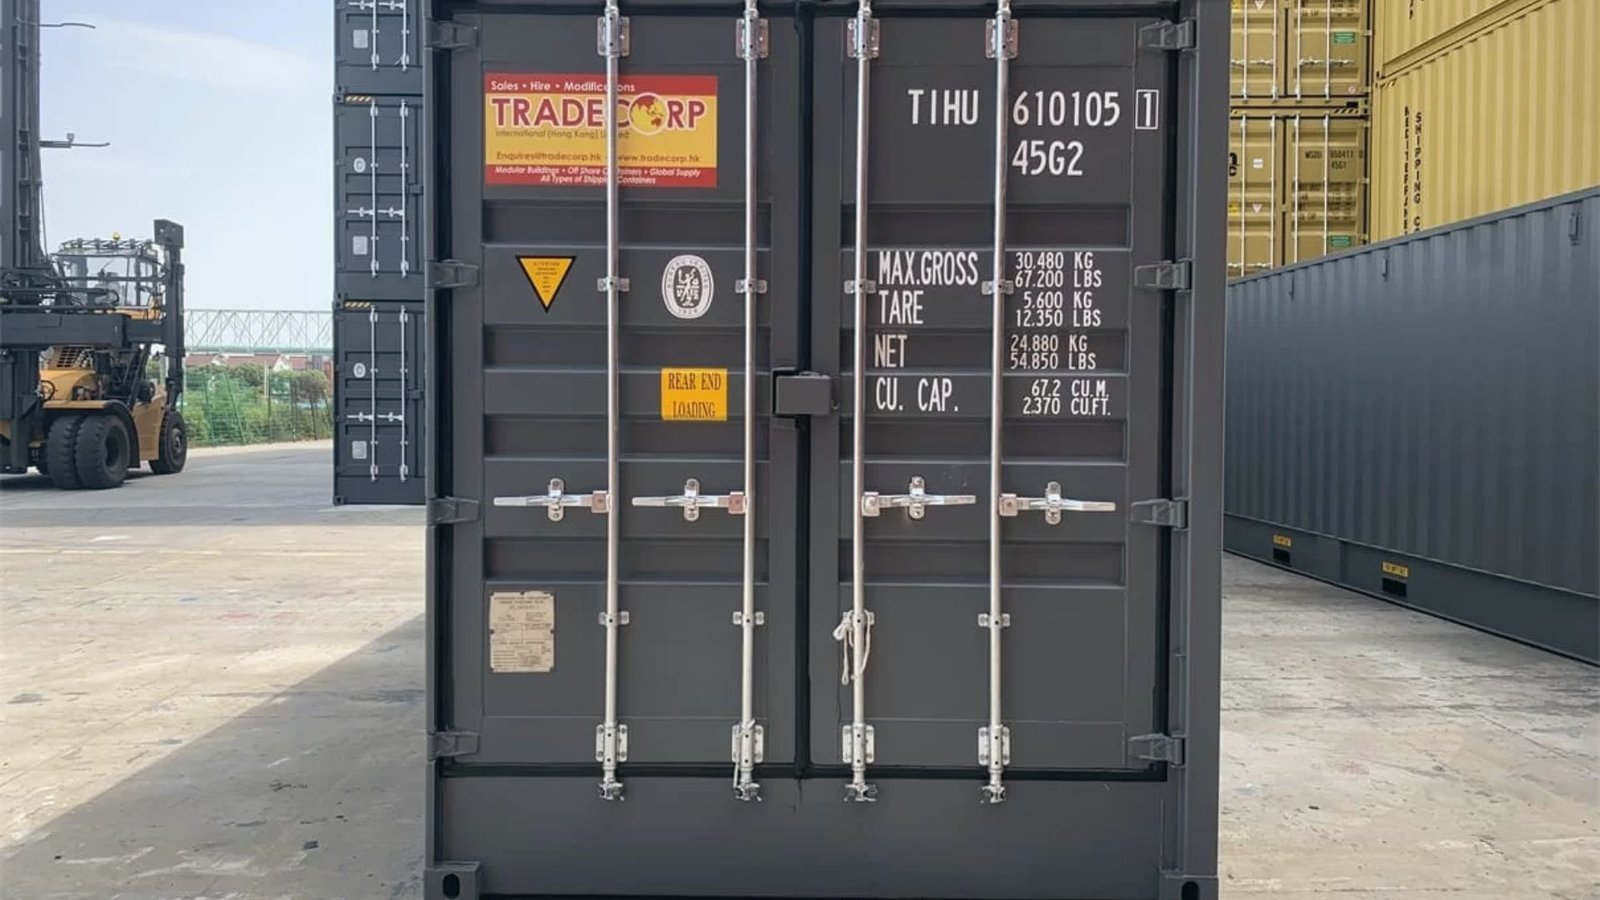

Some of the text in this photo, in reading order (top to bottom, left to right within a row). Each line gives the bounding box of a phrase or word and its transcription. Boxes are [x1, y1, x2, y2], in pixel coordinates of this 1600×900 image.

[491, 81, 636, 93] Sales Hire Modificaons
[908, 89, 979, 125] TIHU
[1013, 91, 1121, 127] 610105
[1012, 140, 1083, 176] 45G2
[551, 175, 573, 185] Types
[649, 168, 675, 176] Global
[676, 168, 701, 178] Supply
[1074, 252, 1093, 269] KG
[1015, 270, 1102, 287] 67.200 LBS
[878, 290, 924, 324] TARE
[1073, 291, 1093, 309] KG
[1073, 309, 1102, 327] LBS
[874, 334, 908, 368] NET
[1010, 334, 1088, 352] 24.880 KG
[1010, 352, 1097, 370] 54.850 LBS
[668, 372, 722, 391] REAR END
[1031, 379, 1061, 397] 67.2
[875, 377, 959, 412] CU. CAP.
[672, 401, 716, 419] LOADING
[1023, 397, 1060, 414] 2.370
